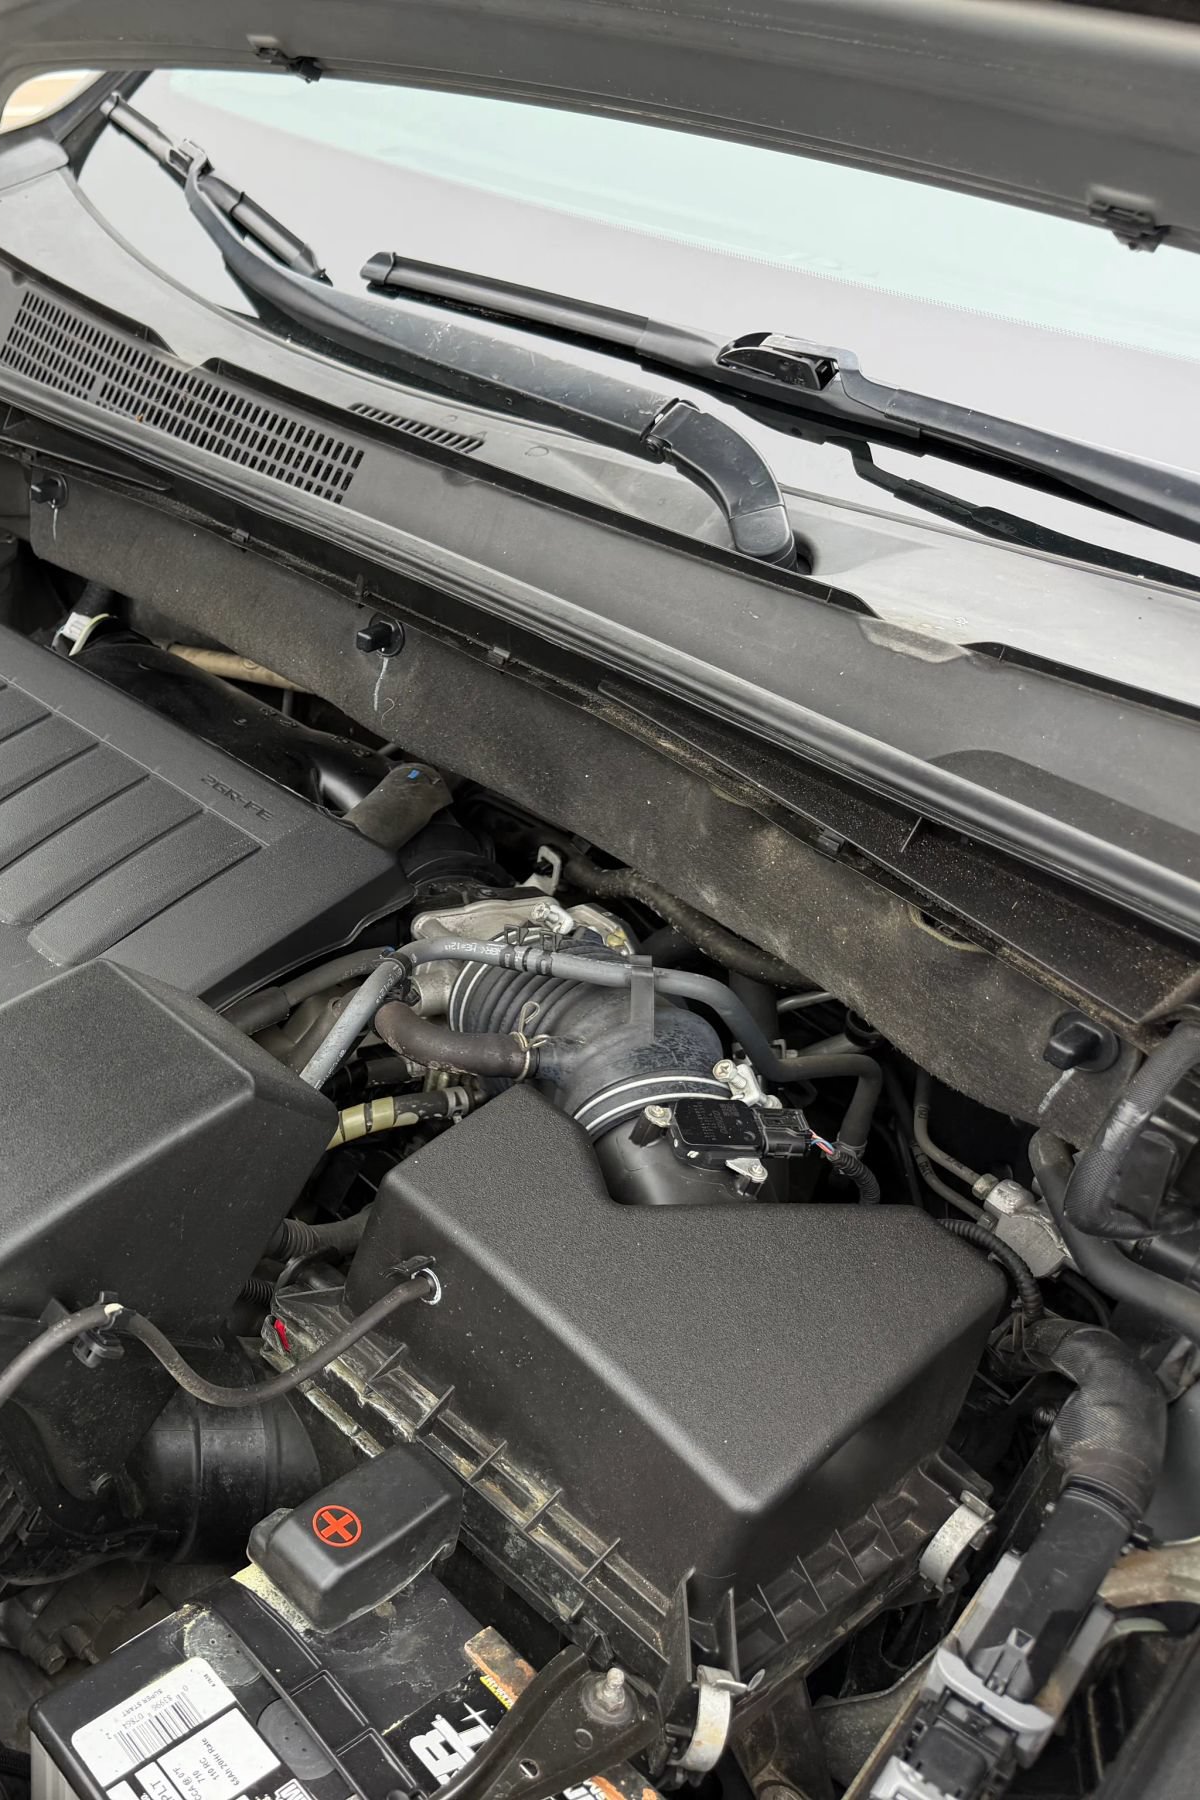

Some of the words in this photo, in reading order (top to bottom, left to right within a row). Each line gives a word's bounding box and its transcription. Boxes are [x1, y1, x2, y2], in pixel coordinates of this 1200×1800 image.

[201, 773, 275, 822] 2GR-FE
[141, 1688, 163, 1705] SUPER
[121, 1701, 143, 1717] START
[201, 1737, 215, 1754] Rate
[199, 1757, 211, 1769] RC
[212, 1753, 228, 1770] 20Hr
[192, 1770, 206, 1784] 710
[207, 1768, 220, 1780] 110
[225, 1767, 240, 1786] 65Ah
